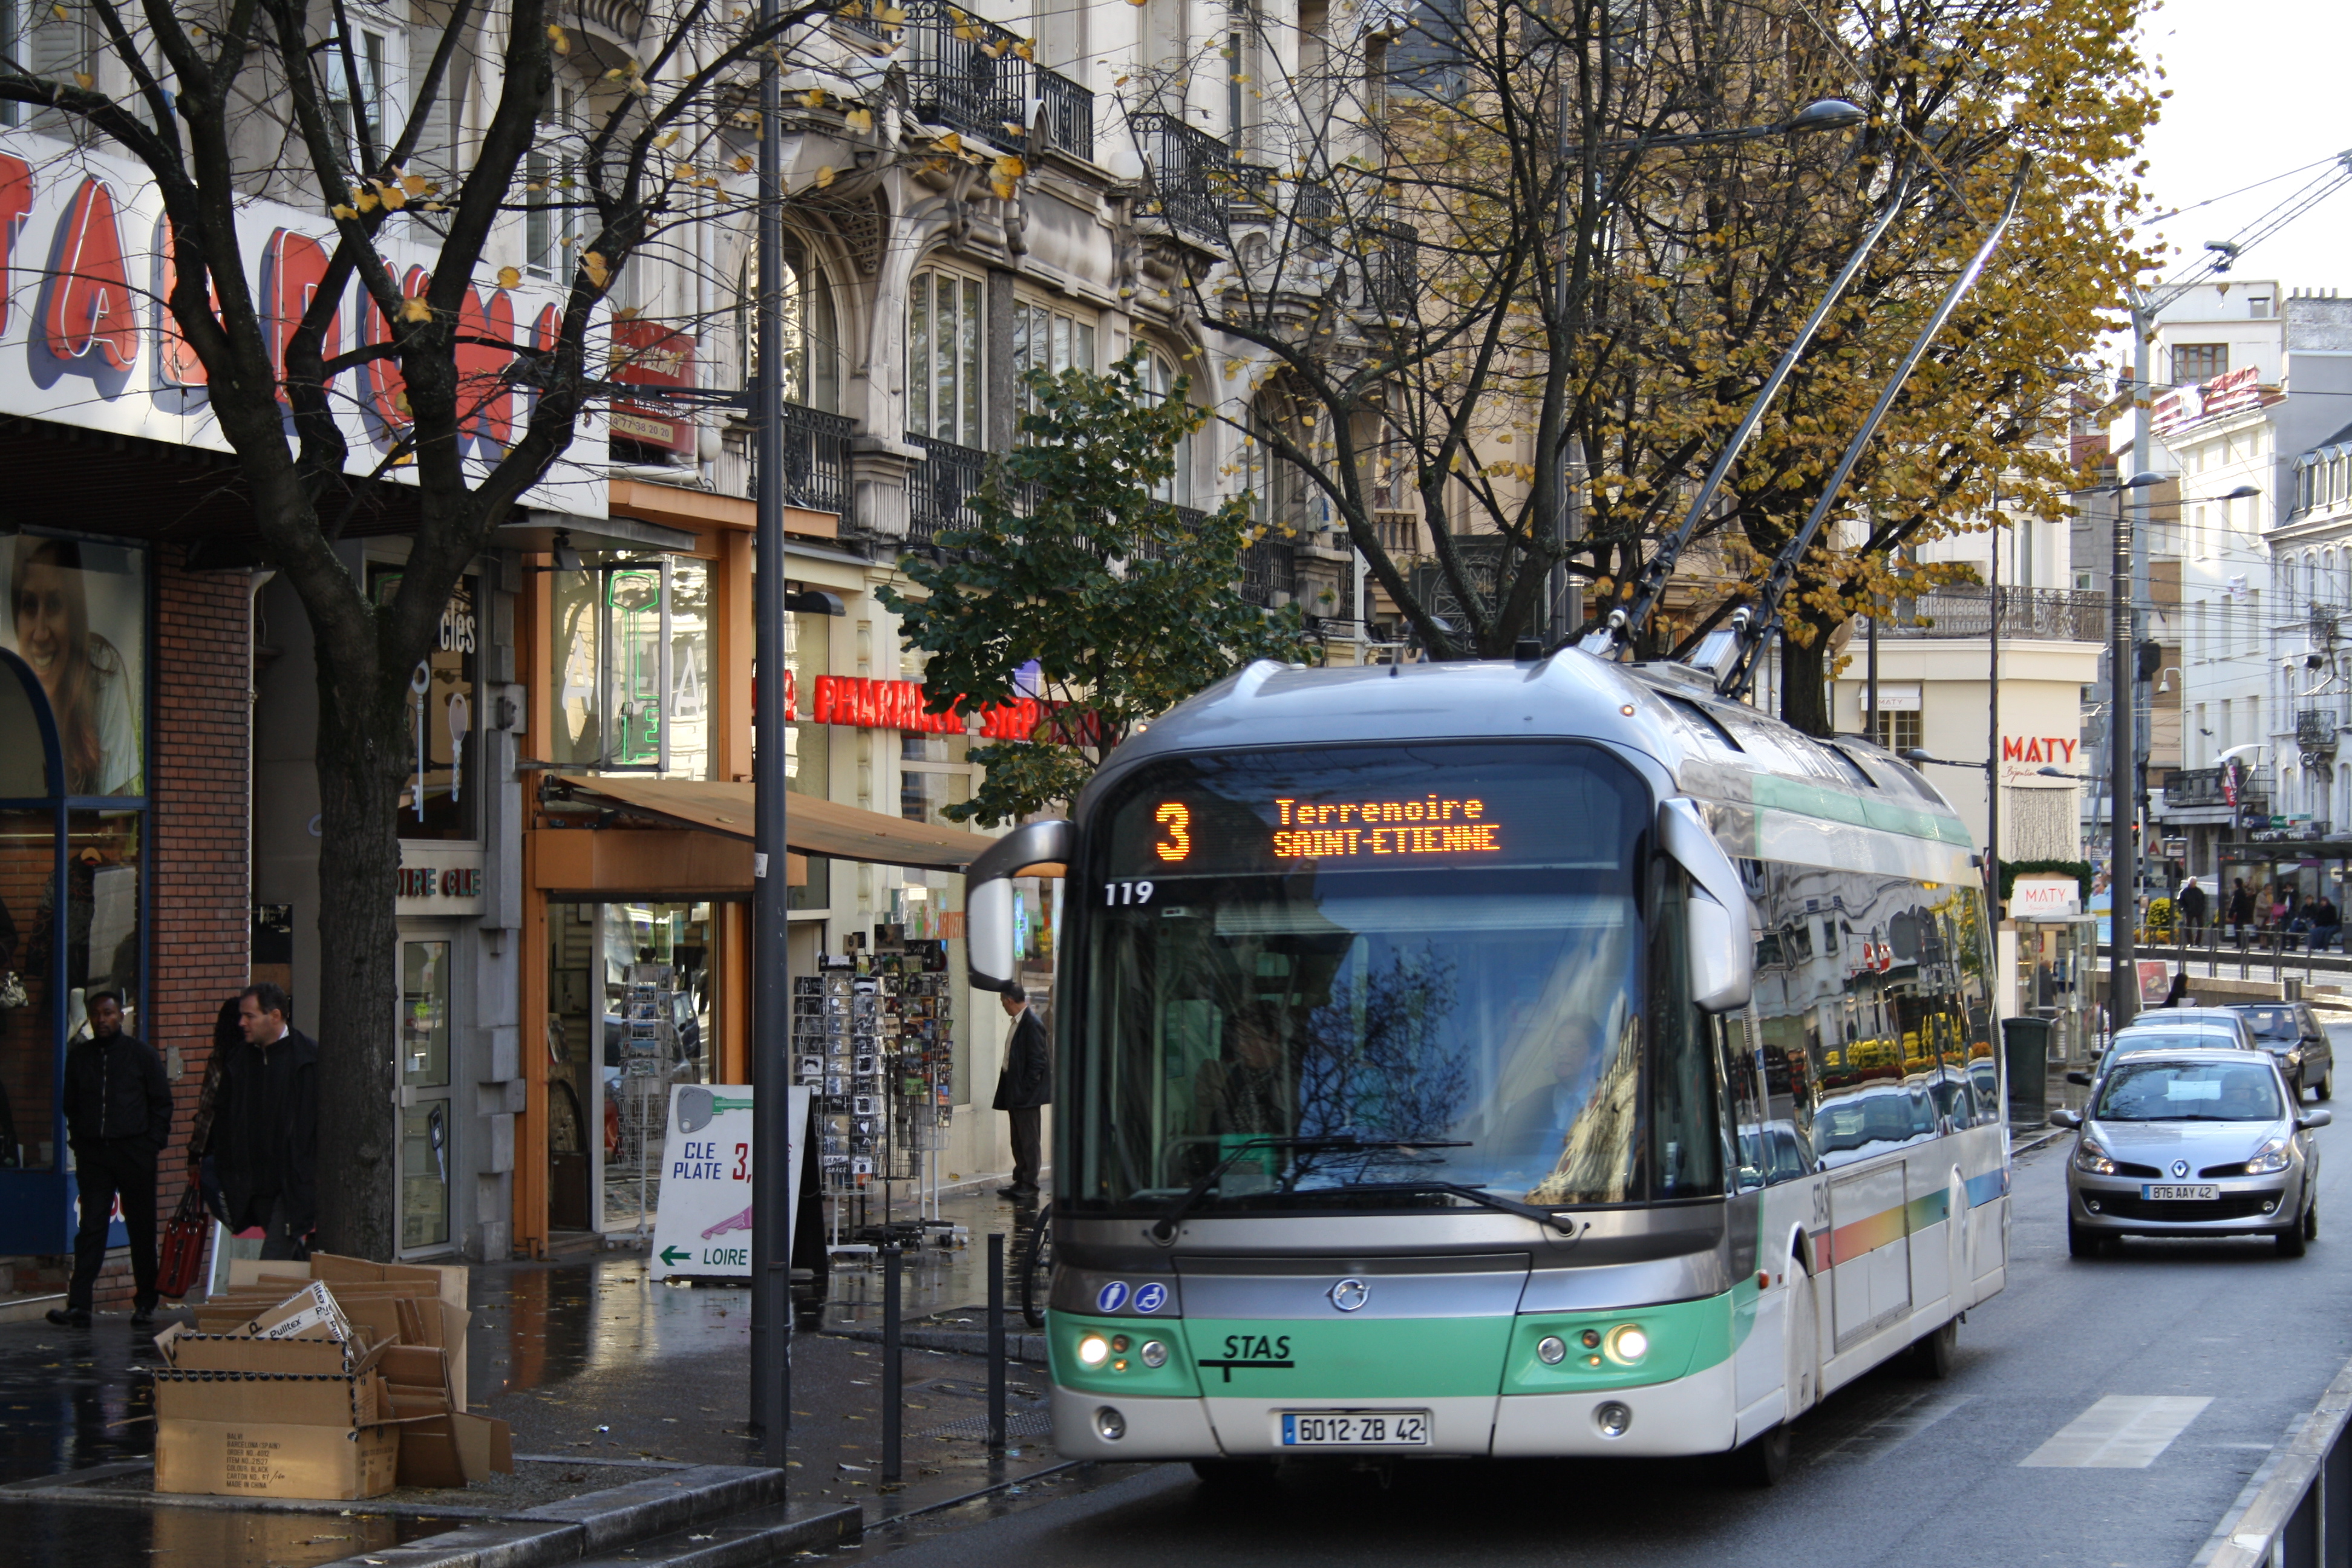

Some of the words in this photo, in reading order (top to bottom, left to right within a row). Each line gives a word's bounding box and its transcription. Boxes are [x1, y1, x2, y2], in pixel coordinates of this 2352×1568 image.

[648, 424, 659, 434] 20
[660, 427, 670, 437] 20
[440, 601, 475, 654] clés
[2003, 736, 2078, 763] MATY
[1275, 794, 1483, 826] Terrenoire
[1156, 802, 1190, 861] 3
[1273, 824, 1500, 857] SAINT-ETIENNE
[442, 868, 481, 897] CLE
[1105, 881, 1154, 906] 119
[2025, 887, 2066, 903] MATY
[684, 1142, 716, 1159] CLE
[673, 1162, 722, 1180] PLATE
[2154, 1187, 2173, 1198] 876
[2176, 1187, 2195, 1198] AAY
[2198, 1187, 2212, 1198] 42
[704, 1248, 748, 1266] LOIRE
[270, 1315, 302, 1338] Pulltex
[1223, 1334, 1291, 1359] STAS
[1301, 1419, 1351, 1441] 6012
[1361, 1419, 1385, 1441] ZB
[1396, 1418, 1421, 1441] 42
